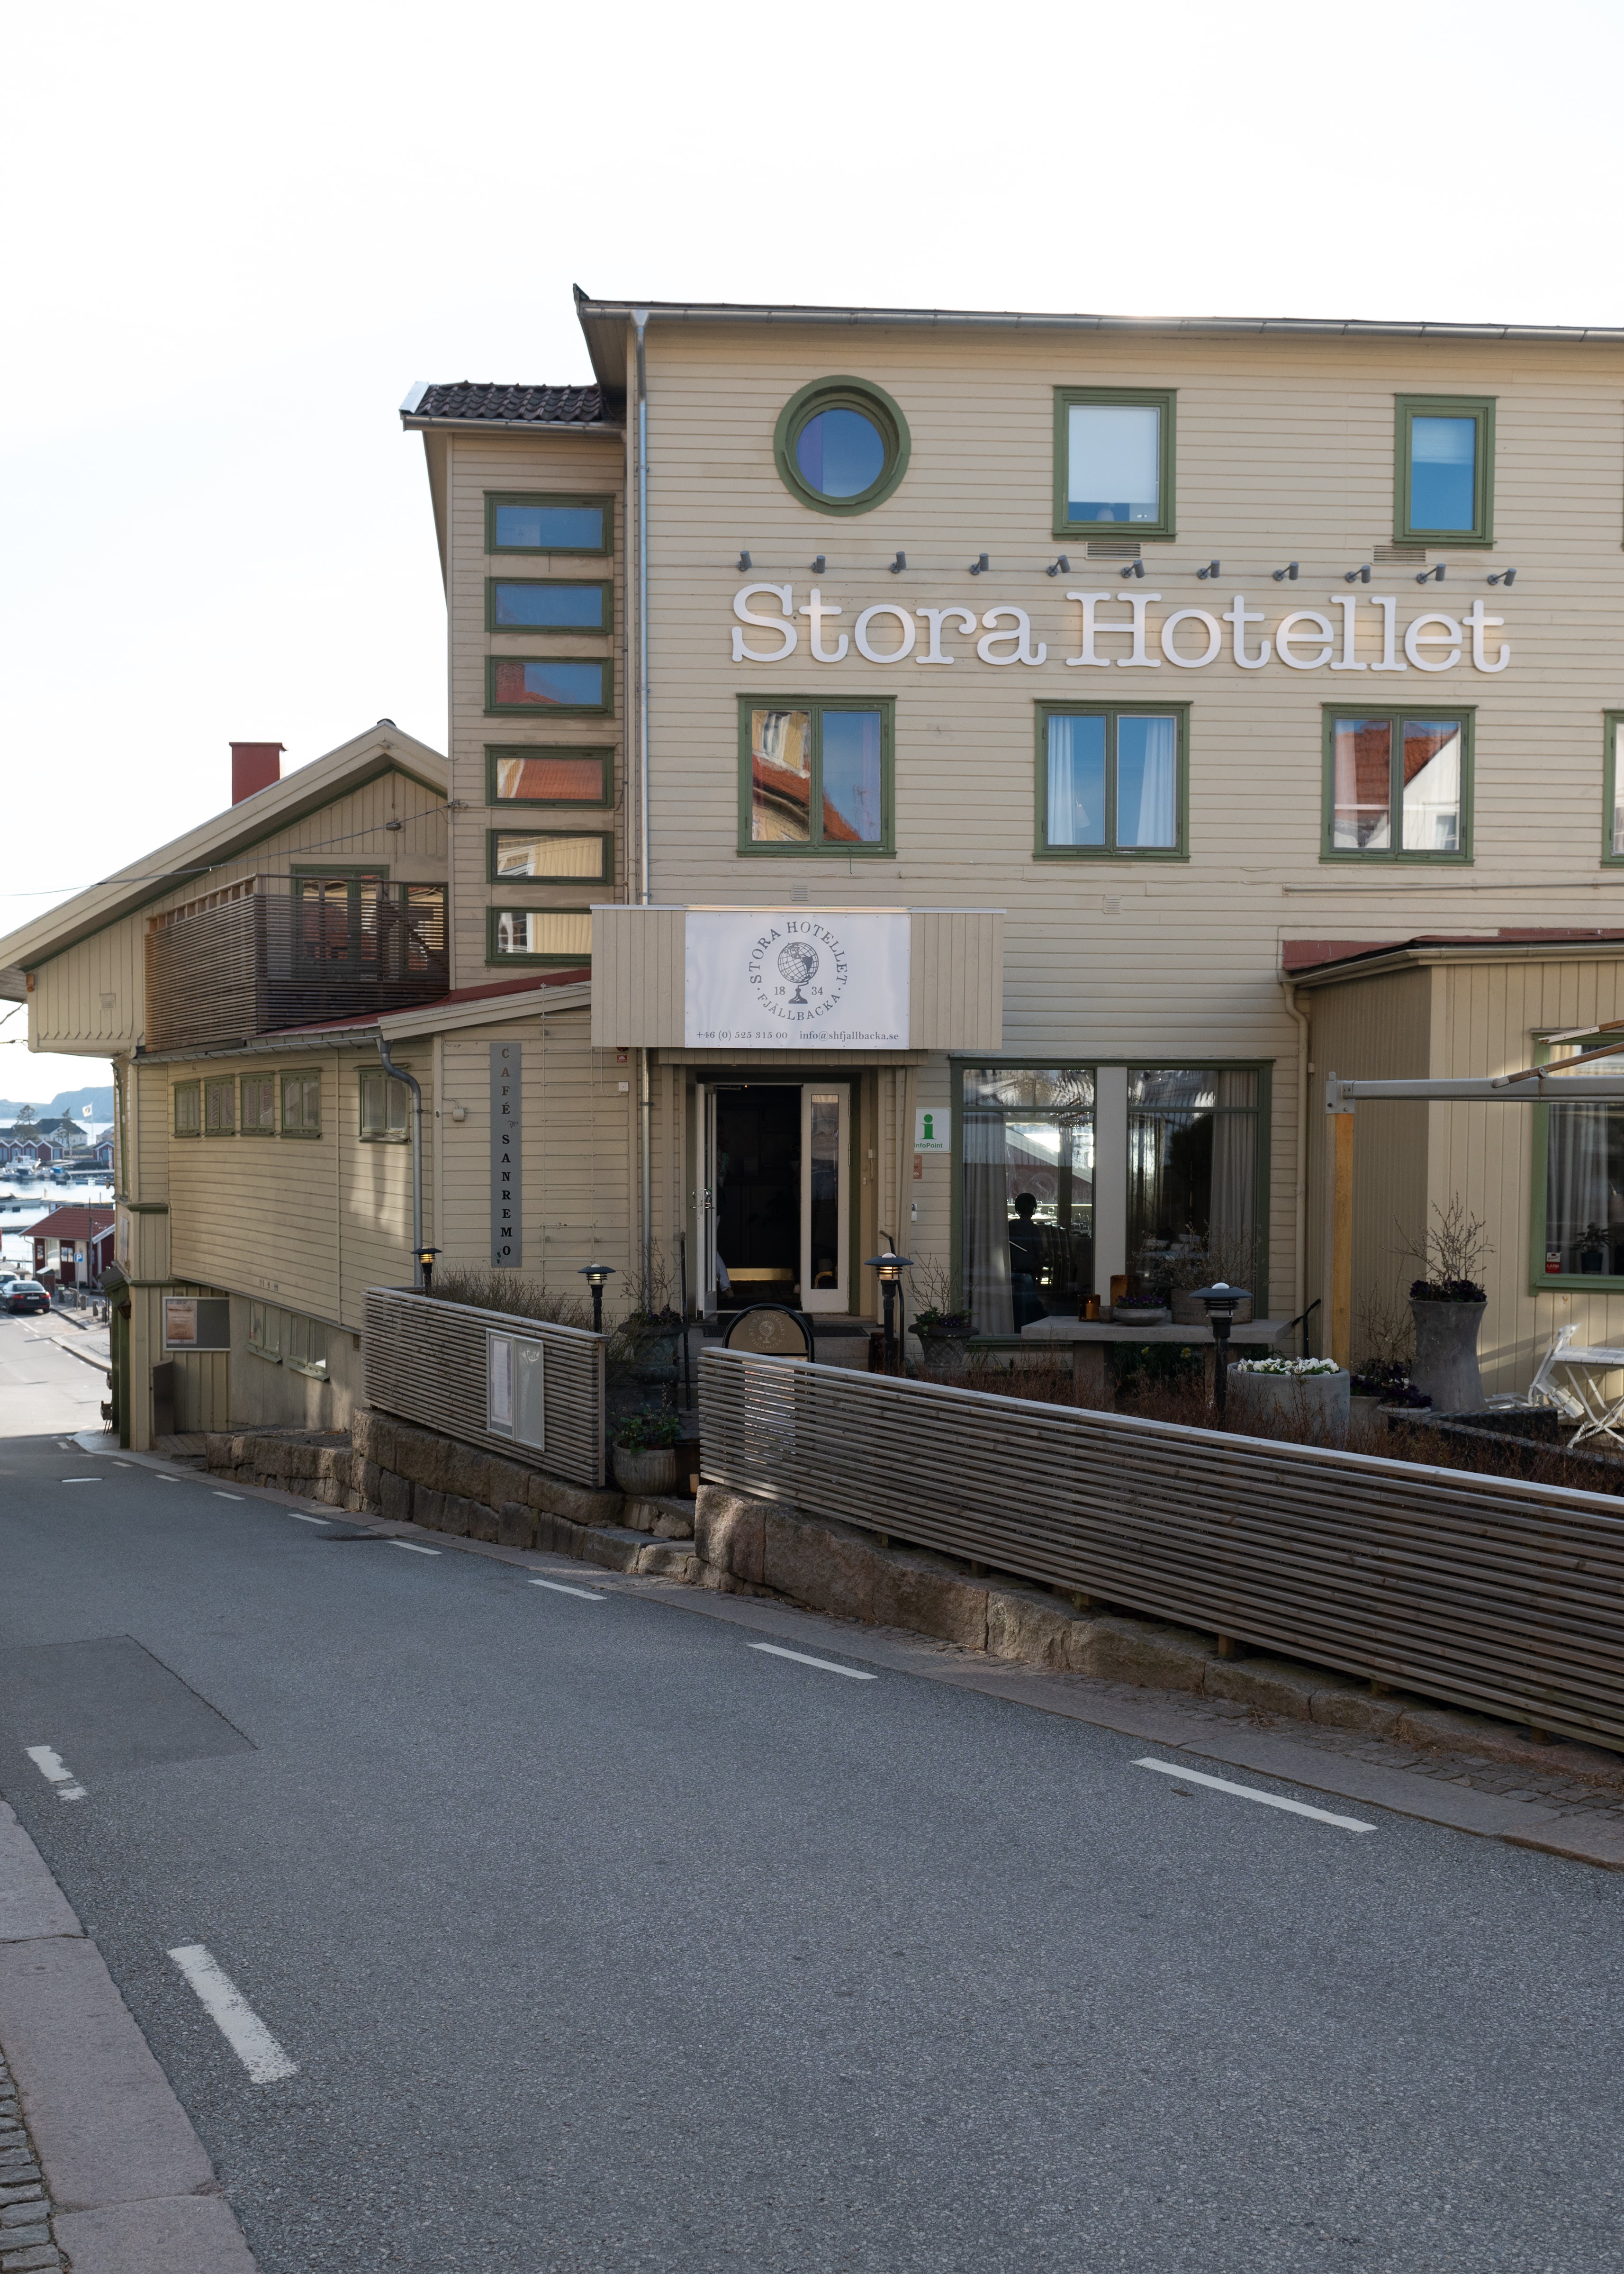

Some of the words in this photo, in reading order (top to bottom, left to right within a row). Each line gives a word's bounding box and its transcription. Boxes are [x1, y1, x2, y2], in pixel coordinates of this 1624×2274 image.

[731, 583, 1047, 666] Stora
[1066, 591, 1511, 673] Hotellet
[749, 928, 781, 984] STORA
[786, 921, 848, 985] HOTELLET
[757, 993, 841, 1021] FJÄLLBACKA
[775, 986, 785, 995] 18
[812, 986, 823, 995] 34
[718, 1030, 731, 1041] (0)
[799, 1031, 899, 1042] info@shfjallbacka.se
[500, 1047, 511, 1114] CAFÉ
[500, 1134, 513, 1256] SANREMO
[749, 1315, 761, 1336] STORA
[763, 1313, 785, 1337] HOTELLET
